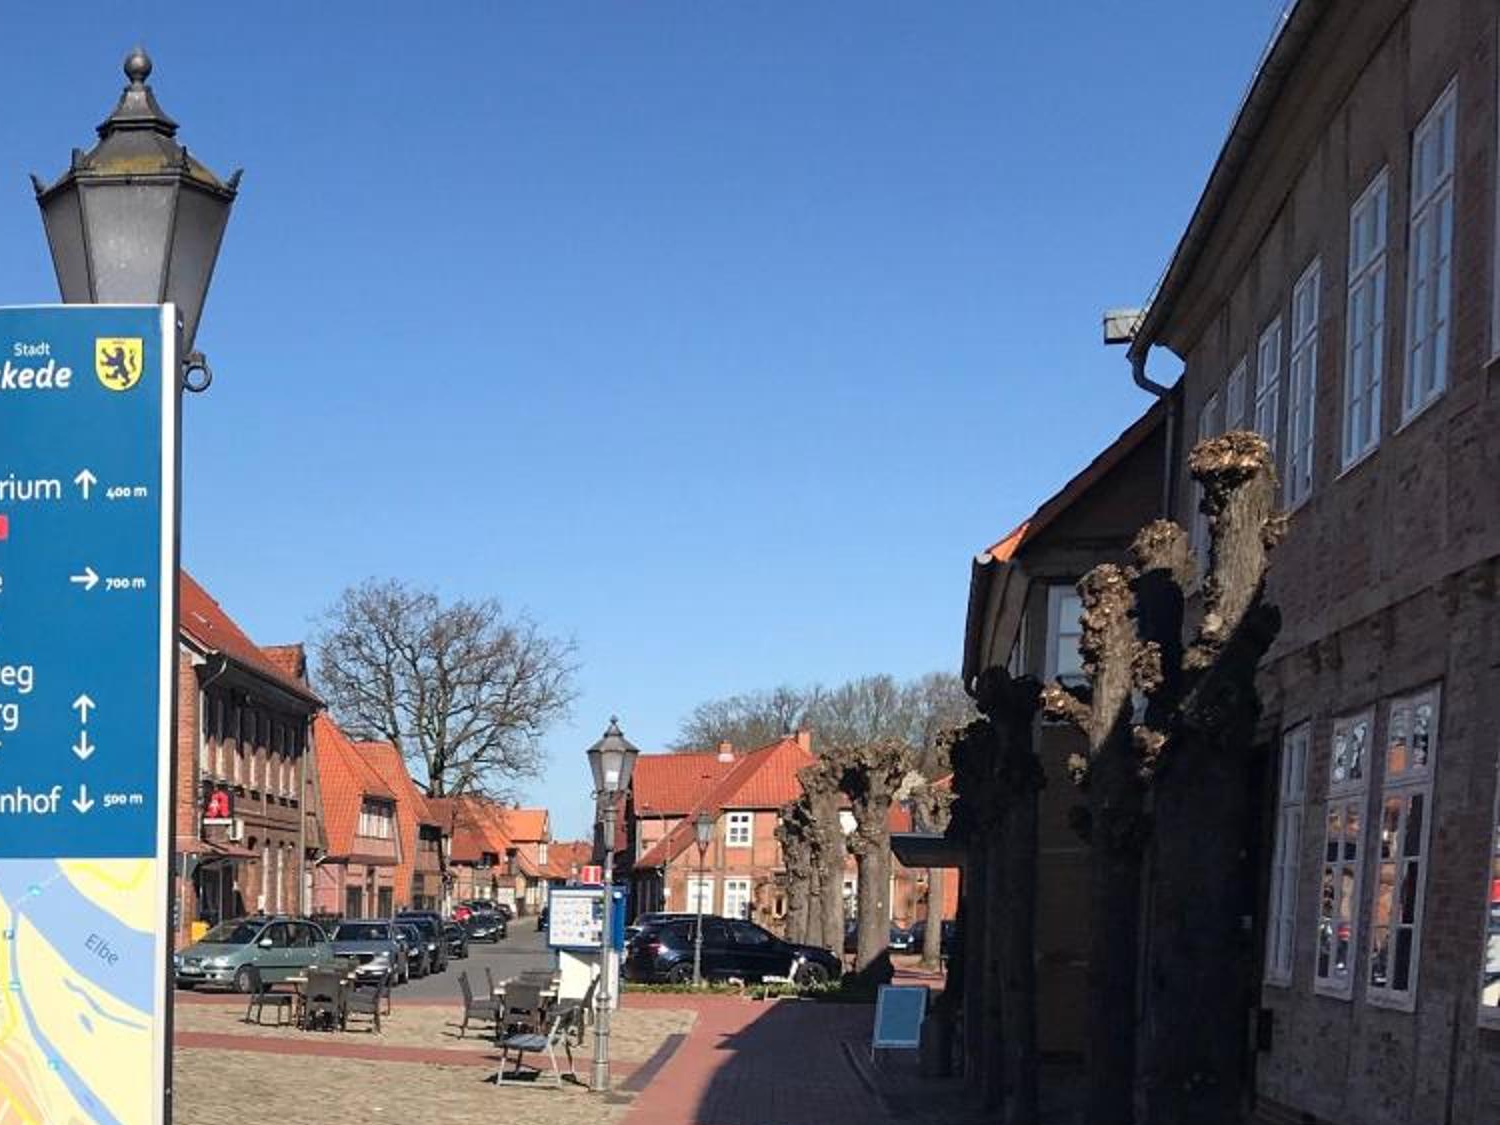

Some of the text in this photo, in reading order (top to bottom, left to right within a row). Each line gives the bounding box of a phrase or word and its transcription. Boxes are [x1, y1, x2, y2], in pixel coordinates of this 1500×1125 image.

[13, 342, 52, 357] Stadt
[106, 487, 131, 500] 400
[133, 486, 148, 498] m
[105, 577, 131, 591] 700
[132, 577, 147, 589] m
[103, 792, 129, 807] 500
[131, 792, 144, 804] m
[85, 933, 119, 967] Elbe
